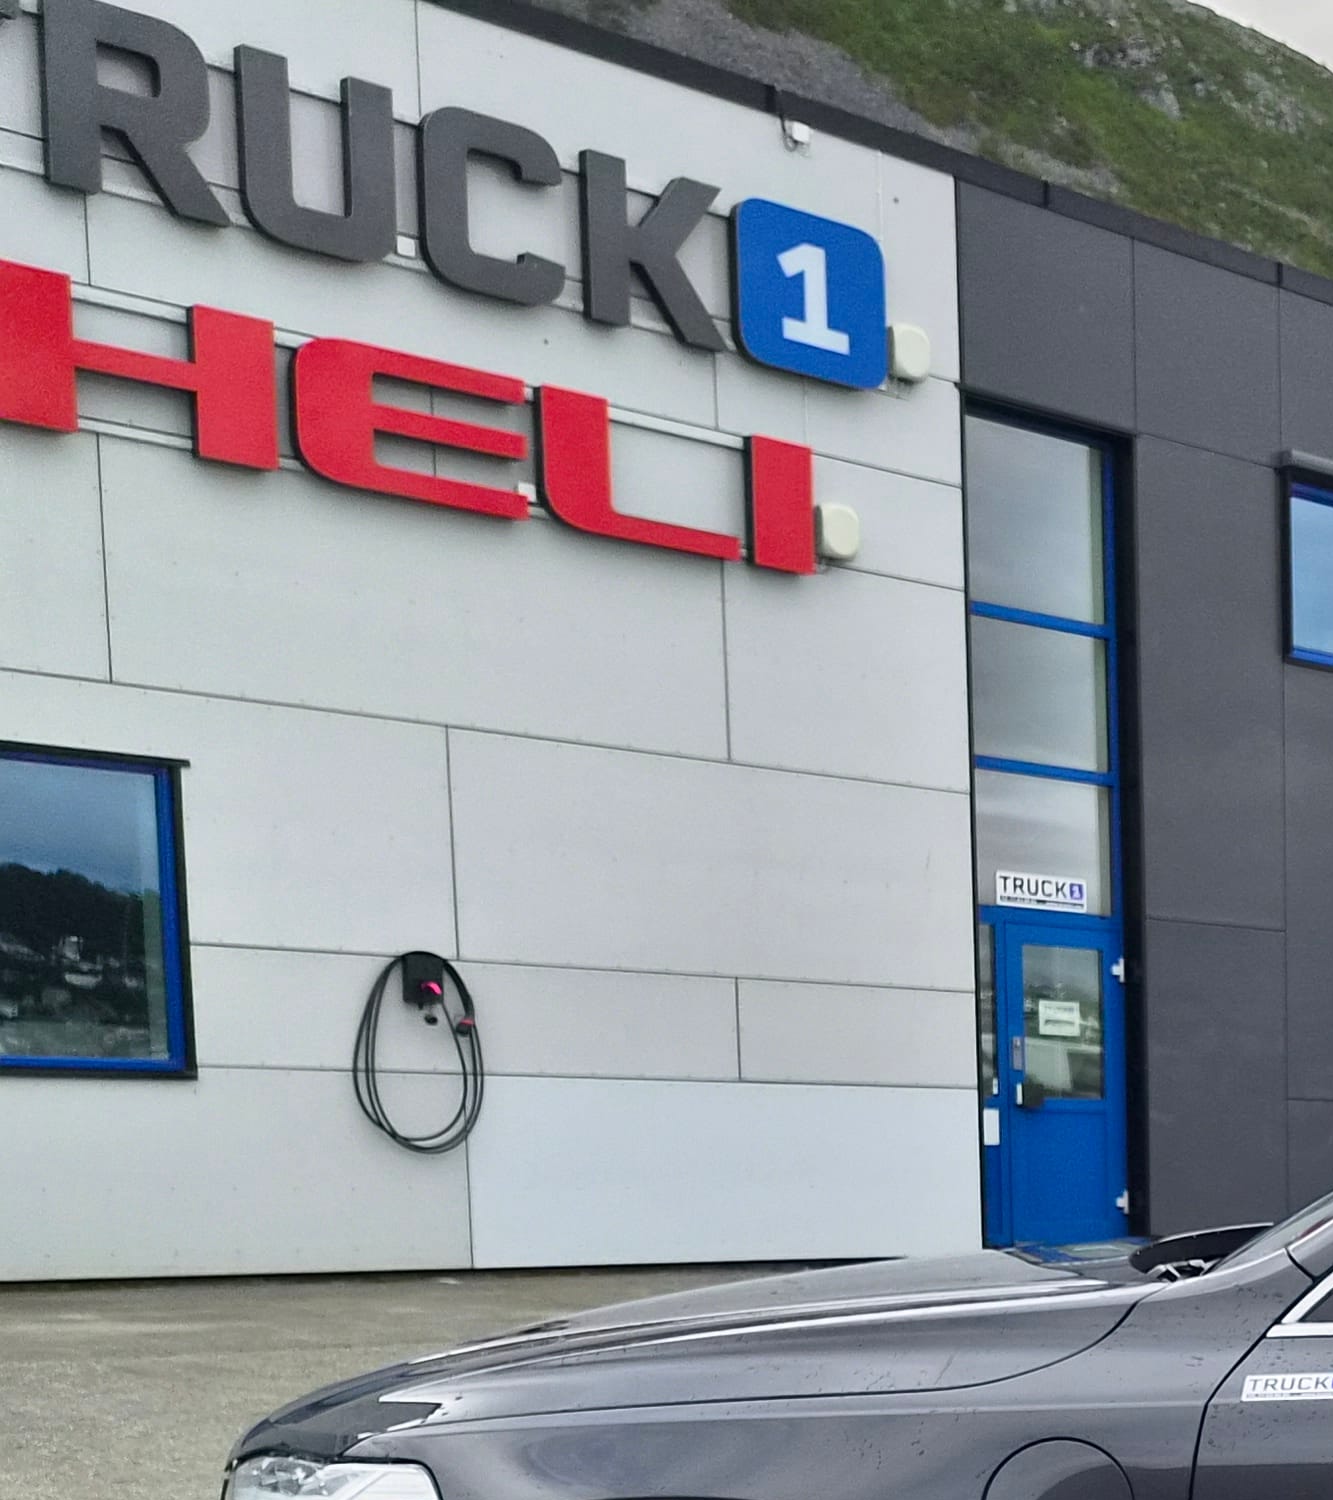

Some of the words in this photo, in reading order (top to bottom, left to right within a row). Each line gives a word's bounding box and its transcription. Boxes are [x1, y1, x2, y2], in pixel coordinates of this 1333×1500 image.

[0, 0, 729, 352] RUCK
[776, 243, 850, 356] 1
[0, 258, 816, 576] HELI
[999, 875, 1067, 899] TRUCK
[1248, 1376, 1329, 1392] TRUCK
